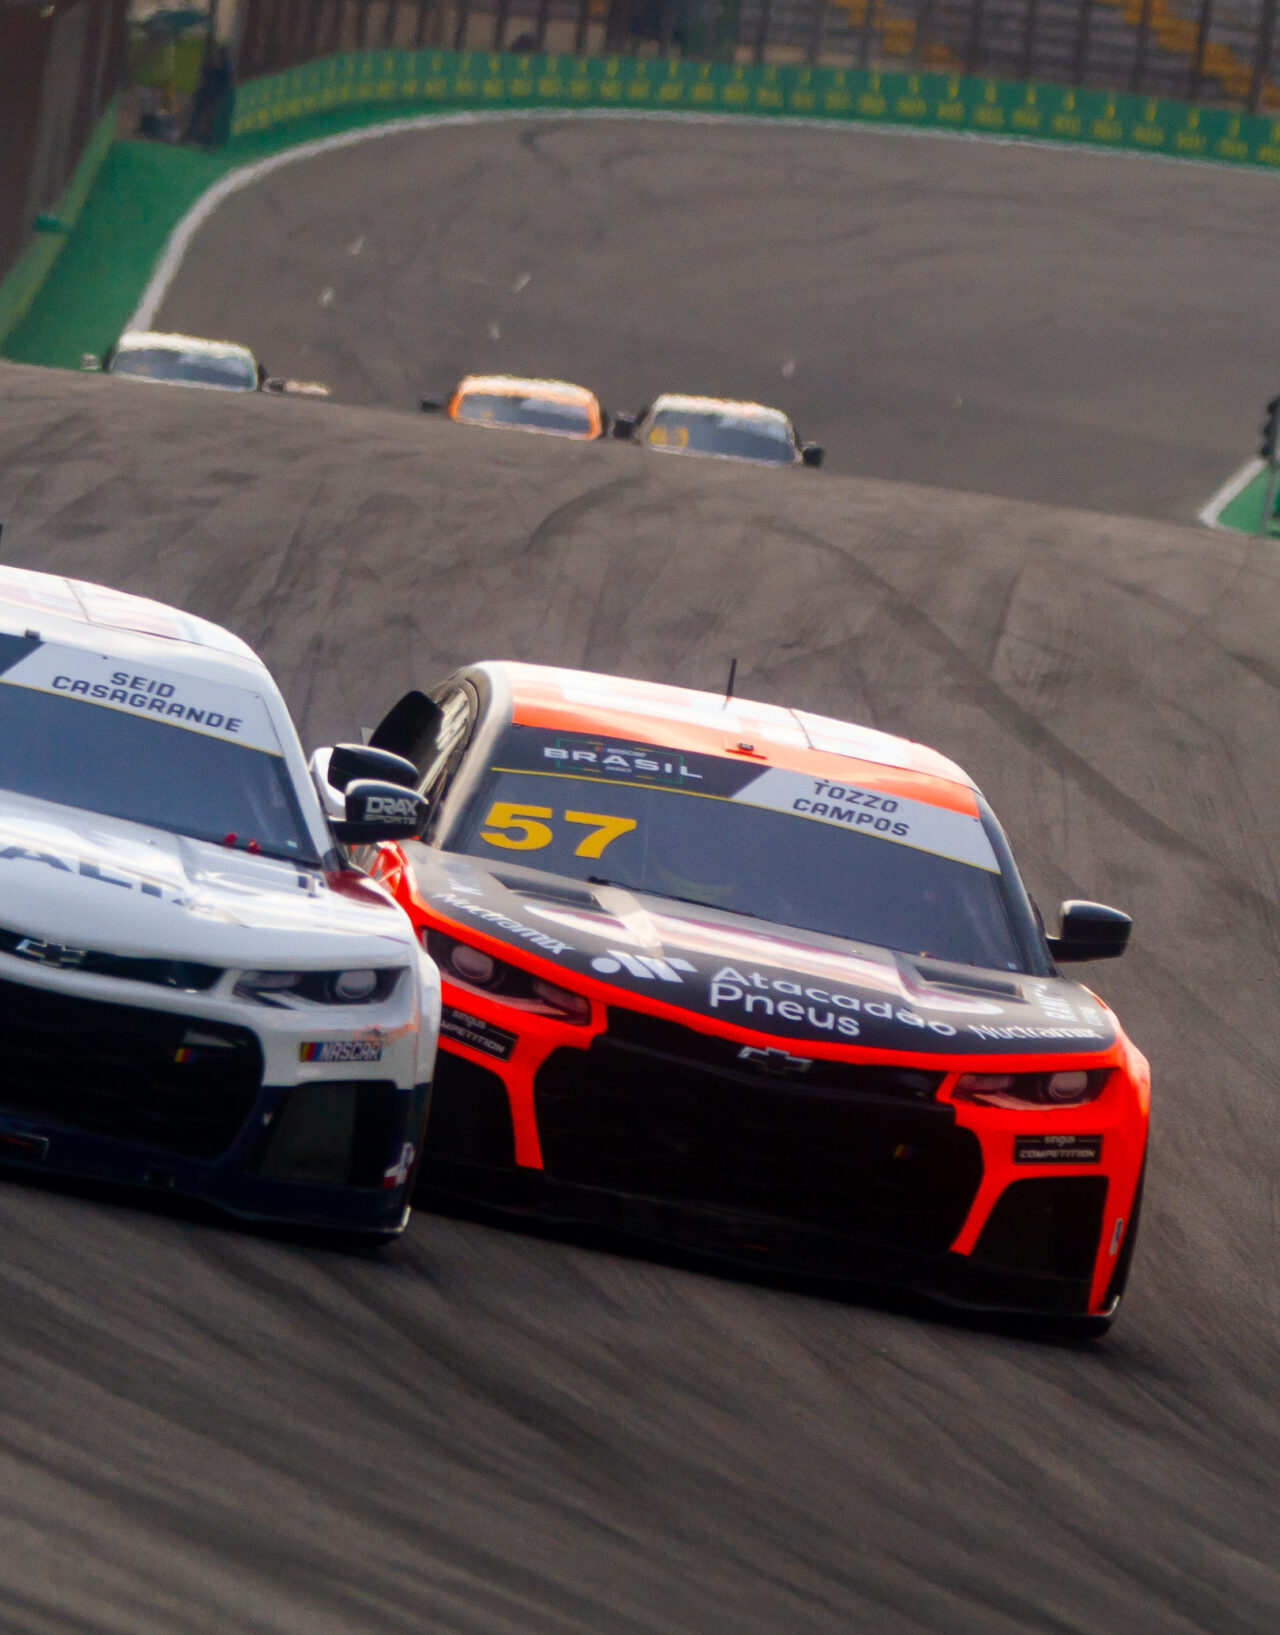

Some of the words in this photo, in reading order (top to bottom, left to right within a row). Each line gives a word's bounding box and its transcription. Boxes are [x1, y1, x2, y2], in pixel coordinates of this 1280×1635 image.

[111, 672, 175, 698] SEID
[52, 676, 243, 733] CASAGRANDE
[543, 747, 703, 779] BRASIL
[366, 797, 418, 816] DRAX
[814, 781, 898, 813] TOZZO
[480, 802, 637, 859] 57
[793, 798, 910, 836] CAMPOS
[708, 983, 860, 1037] Pneus
[712, 966, 957, 1037] Atacadão
[320, 1042, 382, 1061] NASCAR
[1019, 1149, 1096, 1159] COMPETITION
